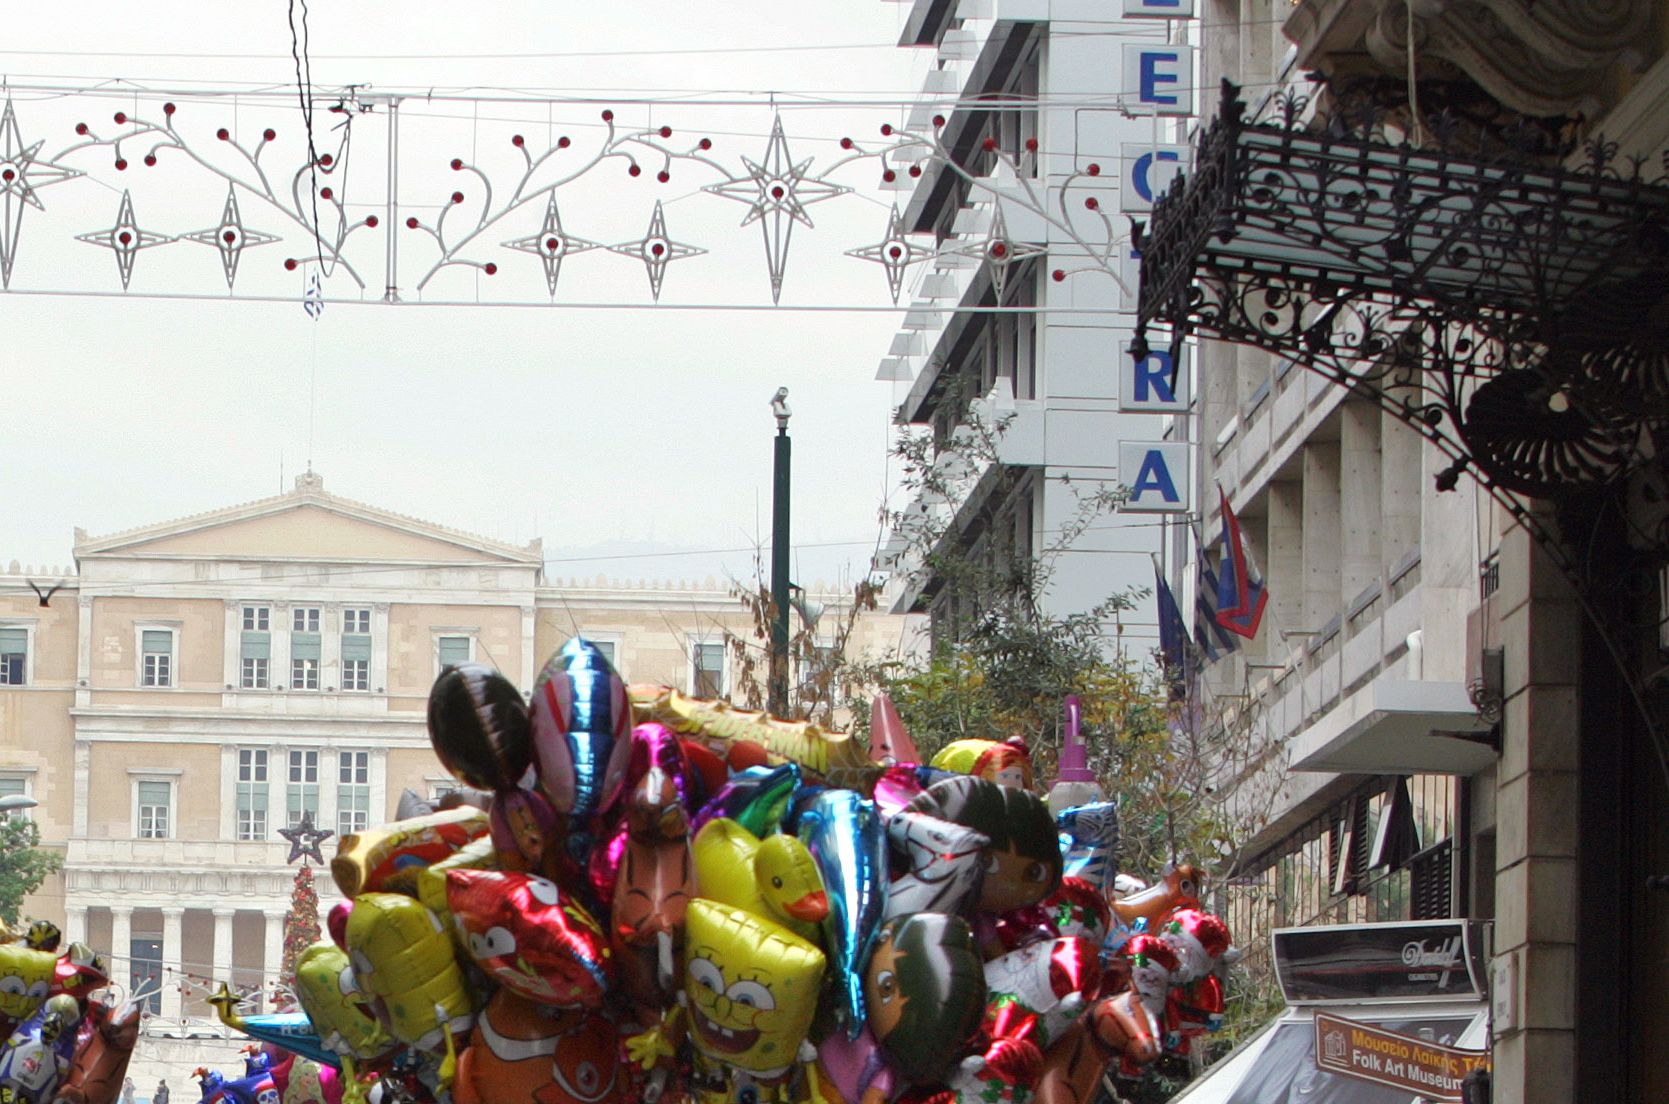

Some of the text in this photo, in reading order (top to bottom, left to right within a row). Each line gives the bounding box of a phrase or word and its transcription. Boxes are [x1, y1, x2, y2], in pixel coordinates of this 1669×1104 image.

[1130, 0, 1180, 502] ECRA
[1352, 1029, 1409, 1060] Μουσείο
[1353, 1049, 1381, 1071] Folk
[1384, 1058, 1405, 1078] Art
